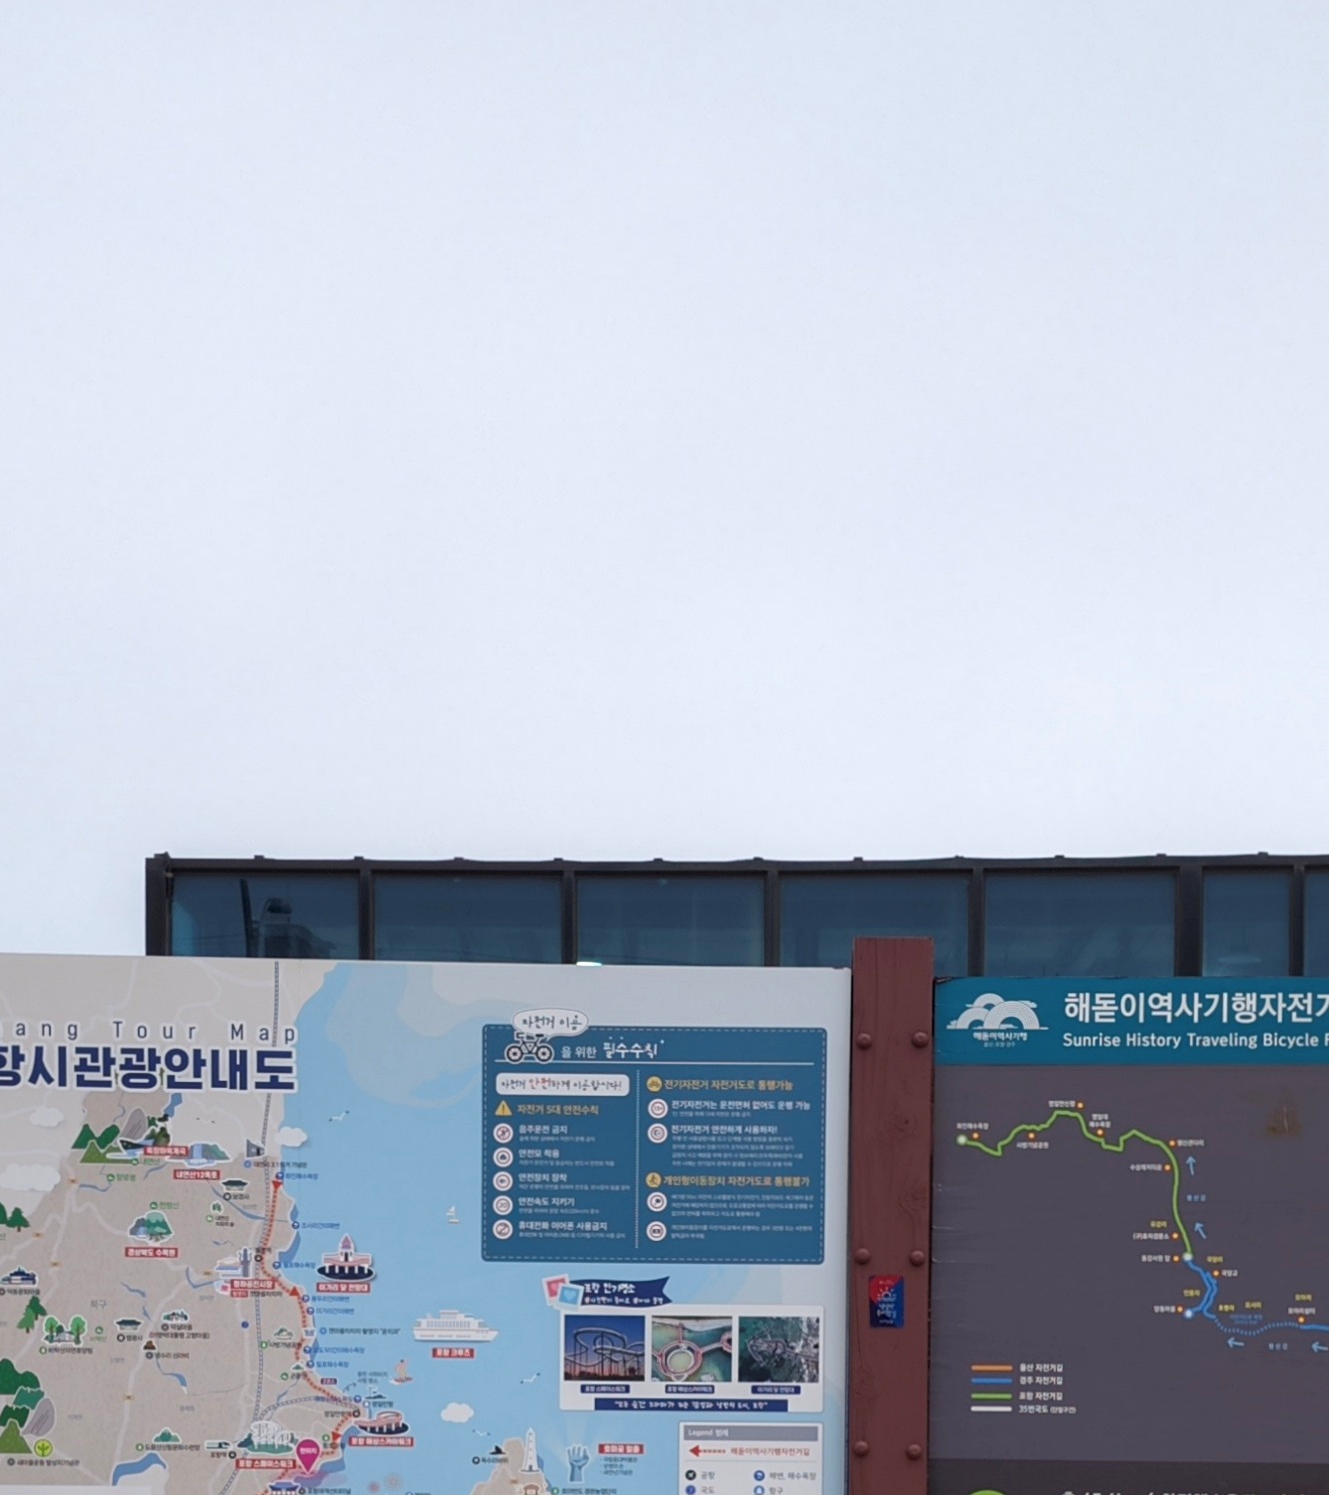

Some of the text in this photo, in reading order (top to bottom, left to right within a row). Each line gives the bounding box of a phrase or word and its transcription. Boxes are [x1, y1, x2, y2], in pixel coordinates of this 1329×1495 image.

[522, 1014, 582, 1031] 자전거 이용
[112, 1020, 197, 1040] Tour
[231, 1023, 296, 1044] Map
[1062, 1032, 1122, 1048] Sunrise
[1126, 1032, 1182, 1052] History
[1187, 1032, 1258, 1052] Traveling
[1262, 1032, 1319, 1052] Bicycle
[561, 1042, 657, 1059] 을 위한 필수수칙
[501, 1077, 622, 1091] 자전거 안전하게 이용합시다!
[664, 1079, 793, 1091] 전기자전거 자전거도로 통행가능
[517, 1104, 599, 1115] 자전거 5대 안전수칙
[671, 1100, 717, 1110] 전기자전거는
[719, 1101, 750, 1110] 운전면허
[795, 1102, 811, 1111] 가능
[519, 1125, 568, 1134] 음주운전 금지
[671, 1125, 778, 1134] 전기자전거 안전하게 사용하자!
[518, 1149, 542, 1158] 안전모
[518, 1173, 550, 1182] 안전장치
[663, 1176, 810, 1187] 개인형이동장치 자전거도로 통행불가
[551, 1197, 575, 1206] 지키기
[518, 1221, 607, 1231] 휴대전화 이어폰 사용금지
[584, 1283, 600, 1294] 포항
[1019, 1363, 1063, 1372] 울산 자전거길
[1019, 1376, 1063, 1385] 경주 자전거길
[1019, 1392, 1063, 1401] 포항 자전거길
[688, 1429, 713, 1438] Legend
[730, 1447, 810, 1456] 해돋이역사기행자전거길
[700, 1471, 715, 1480] 공항
[700, 1486, 715, 1494] 국도
[769, 1486, 783, 1495] 항구
